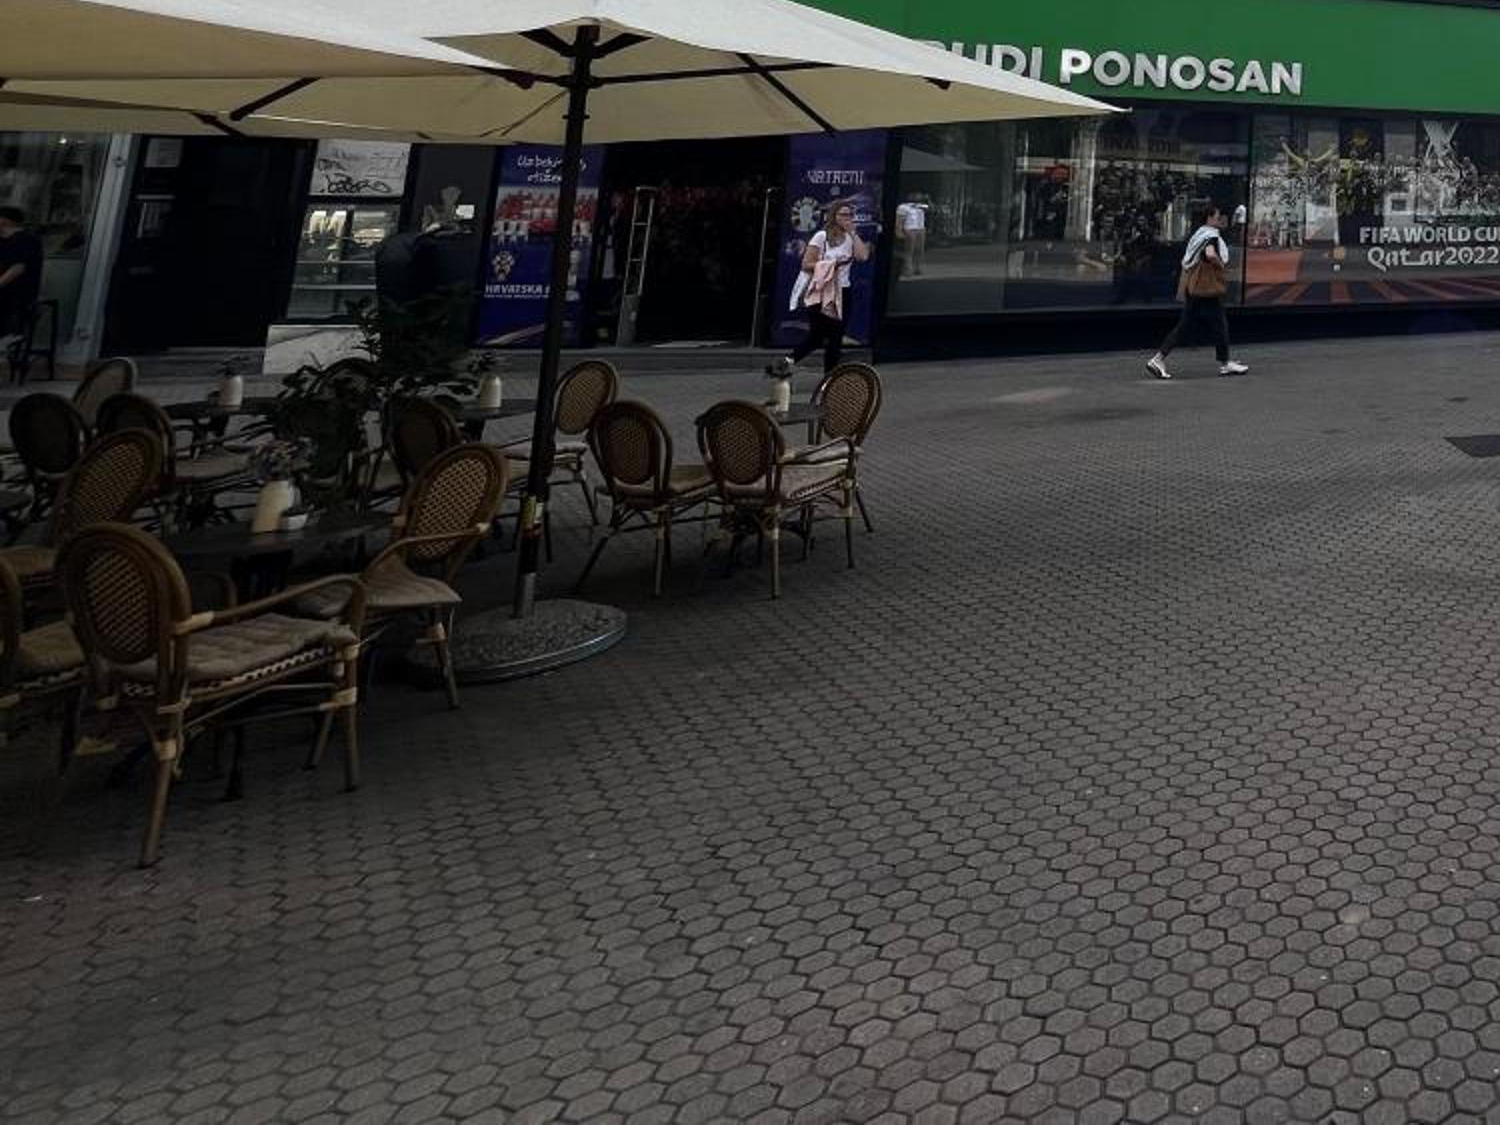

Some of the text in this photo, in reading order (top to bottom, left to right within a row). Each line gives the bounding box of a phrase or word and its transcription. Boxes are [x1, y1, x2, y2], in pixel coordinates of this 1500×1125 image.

[925, 40, 1303, 96] UDI PONOSAN
[1359, 226, 1401, 244] FIFA
[1404, 225, 1471, 243] WORLD
